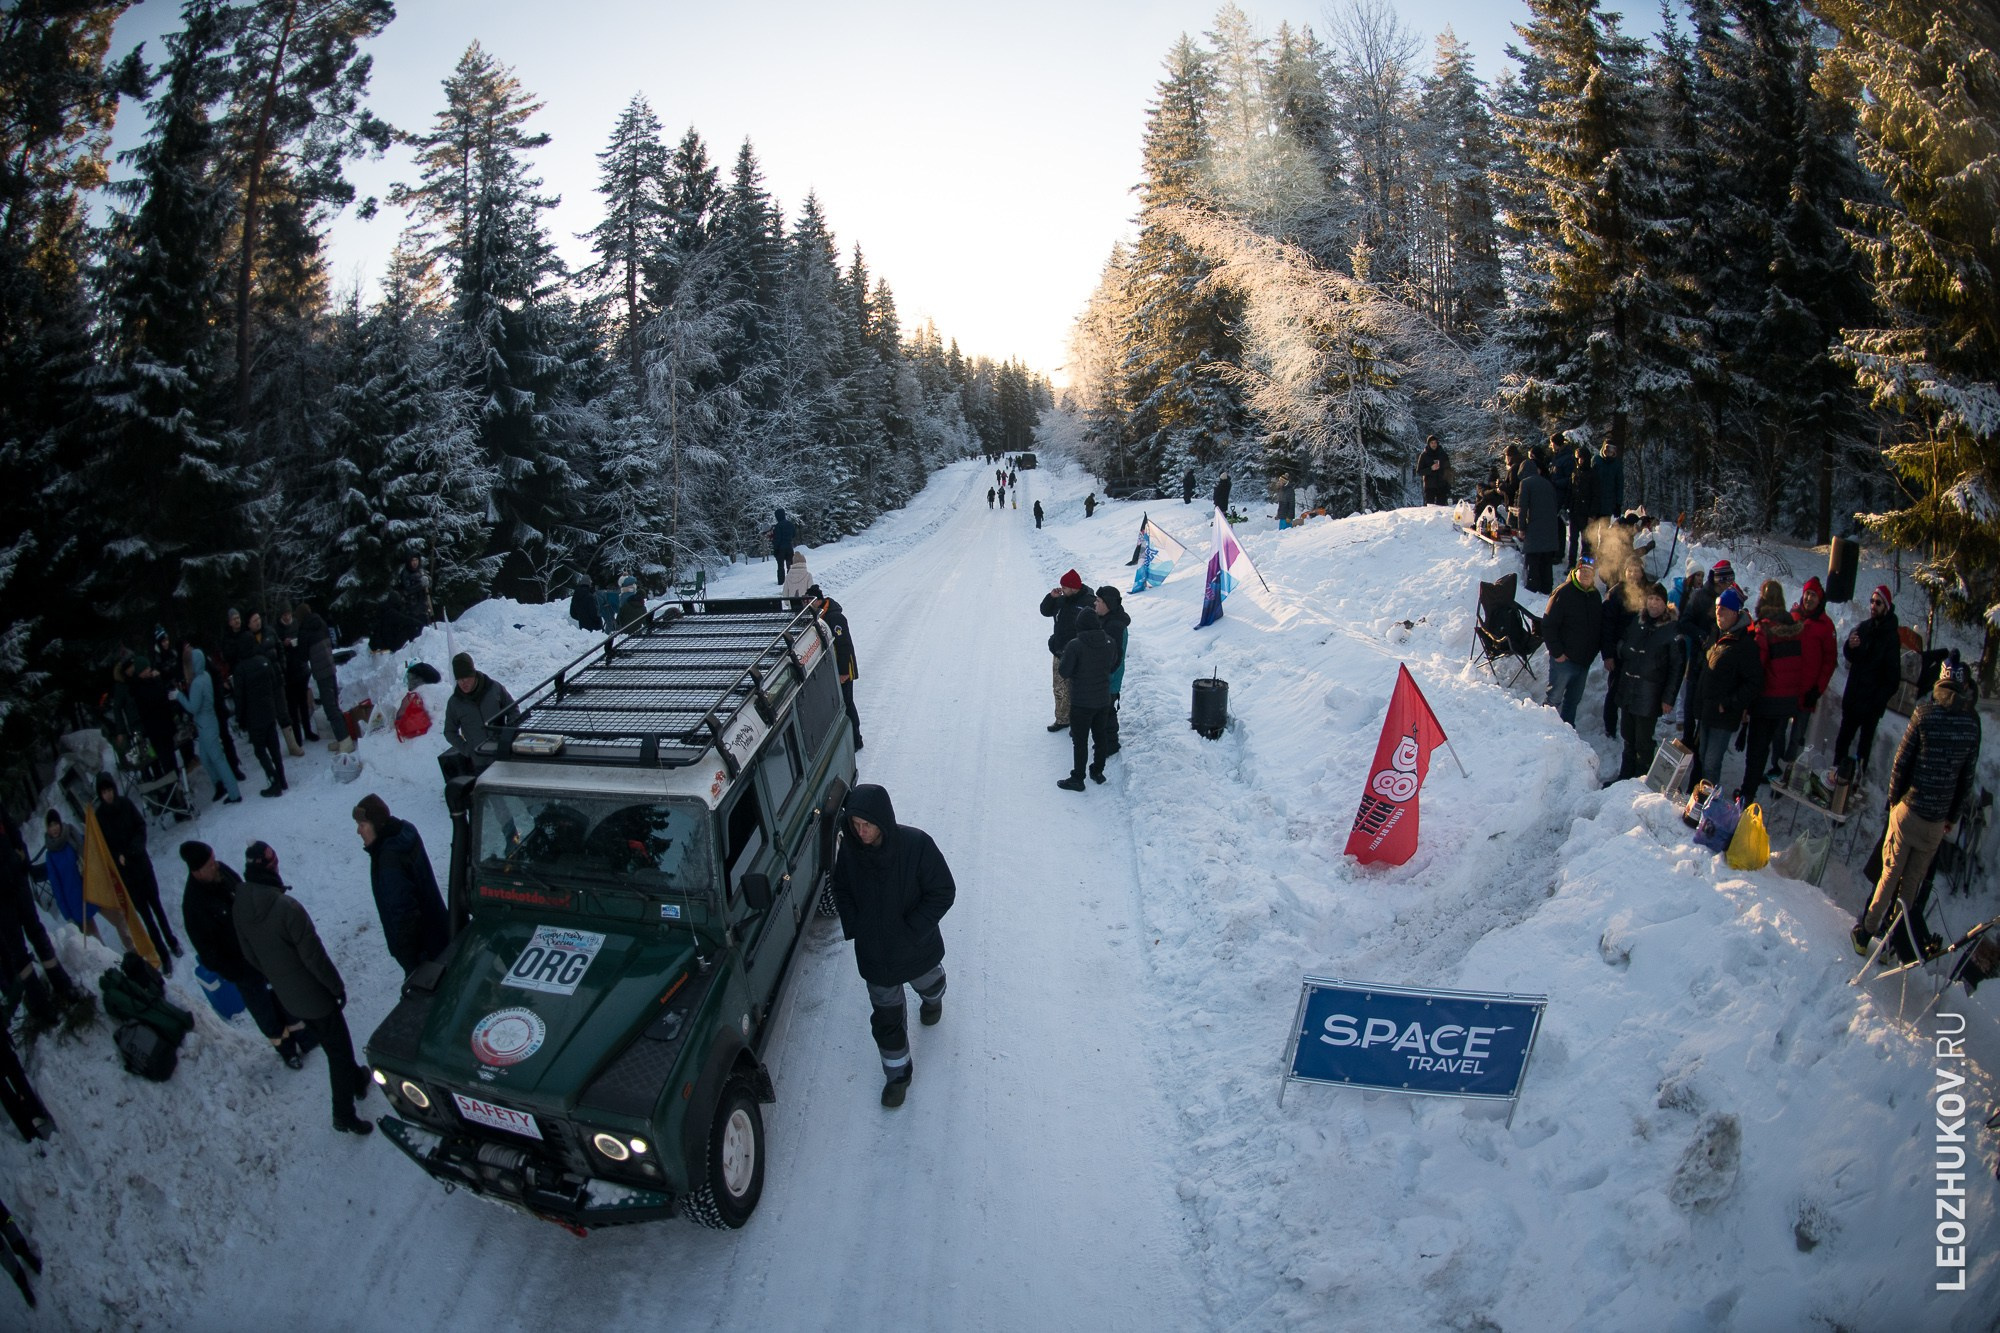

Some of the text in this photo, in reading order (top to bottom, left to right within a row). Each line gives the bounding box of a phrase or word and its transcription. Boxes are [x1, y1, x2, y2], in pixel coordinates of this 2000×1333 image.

[513, 947, 589, 985] ORG
[1320, 1014, 1496, 1058] SPACE
[1406, 1055, 1484, 1075] TRAVEL
[458, 1096, 529, 1127] SAFETY
[465, 1111, 538, 1137] БЕЗОПАСНОСТЬ
